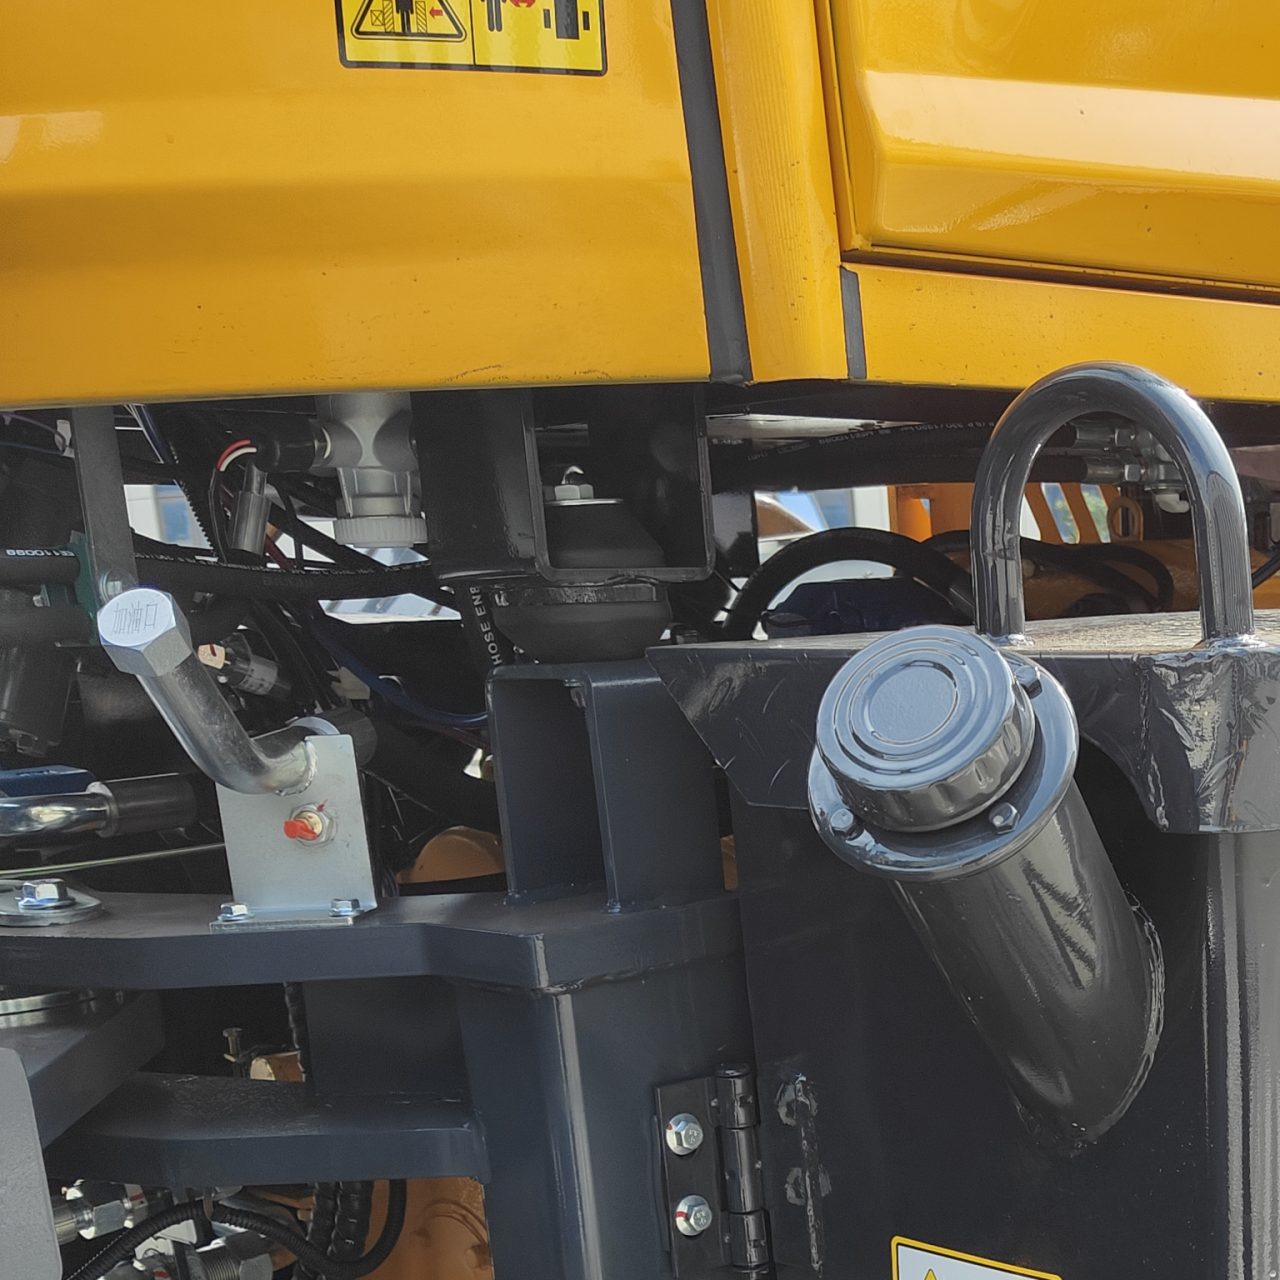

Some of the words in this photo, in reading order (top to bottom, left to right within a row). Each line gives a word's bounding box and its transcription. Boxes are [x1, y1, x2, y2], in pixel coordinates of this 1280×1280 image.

[112, 600, 159, 635] 加油口
[480, 621, 502, 665] HOSE
